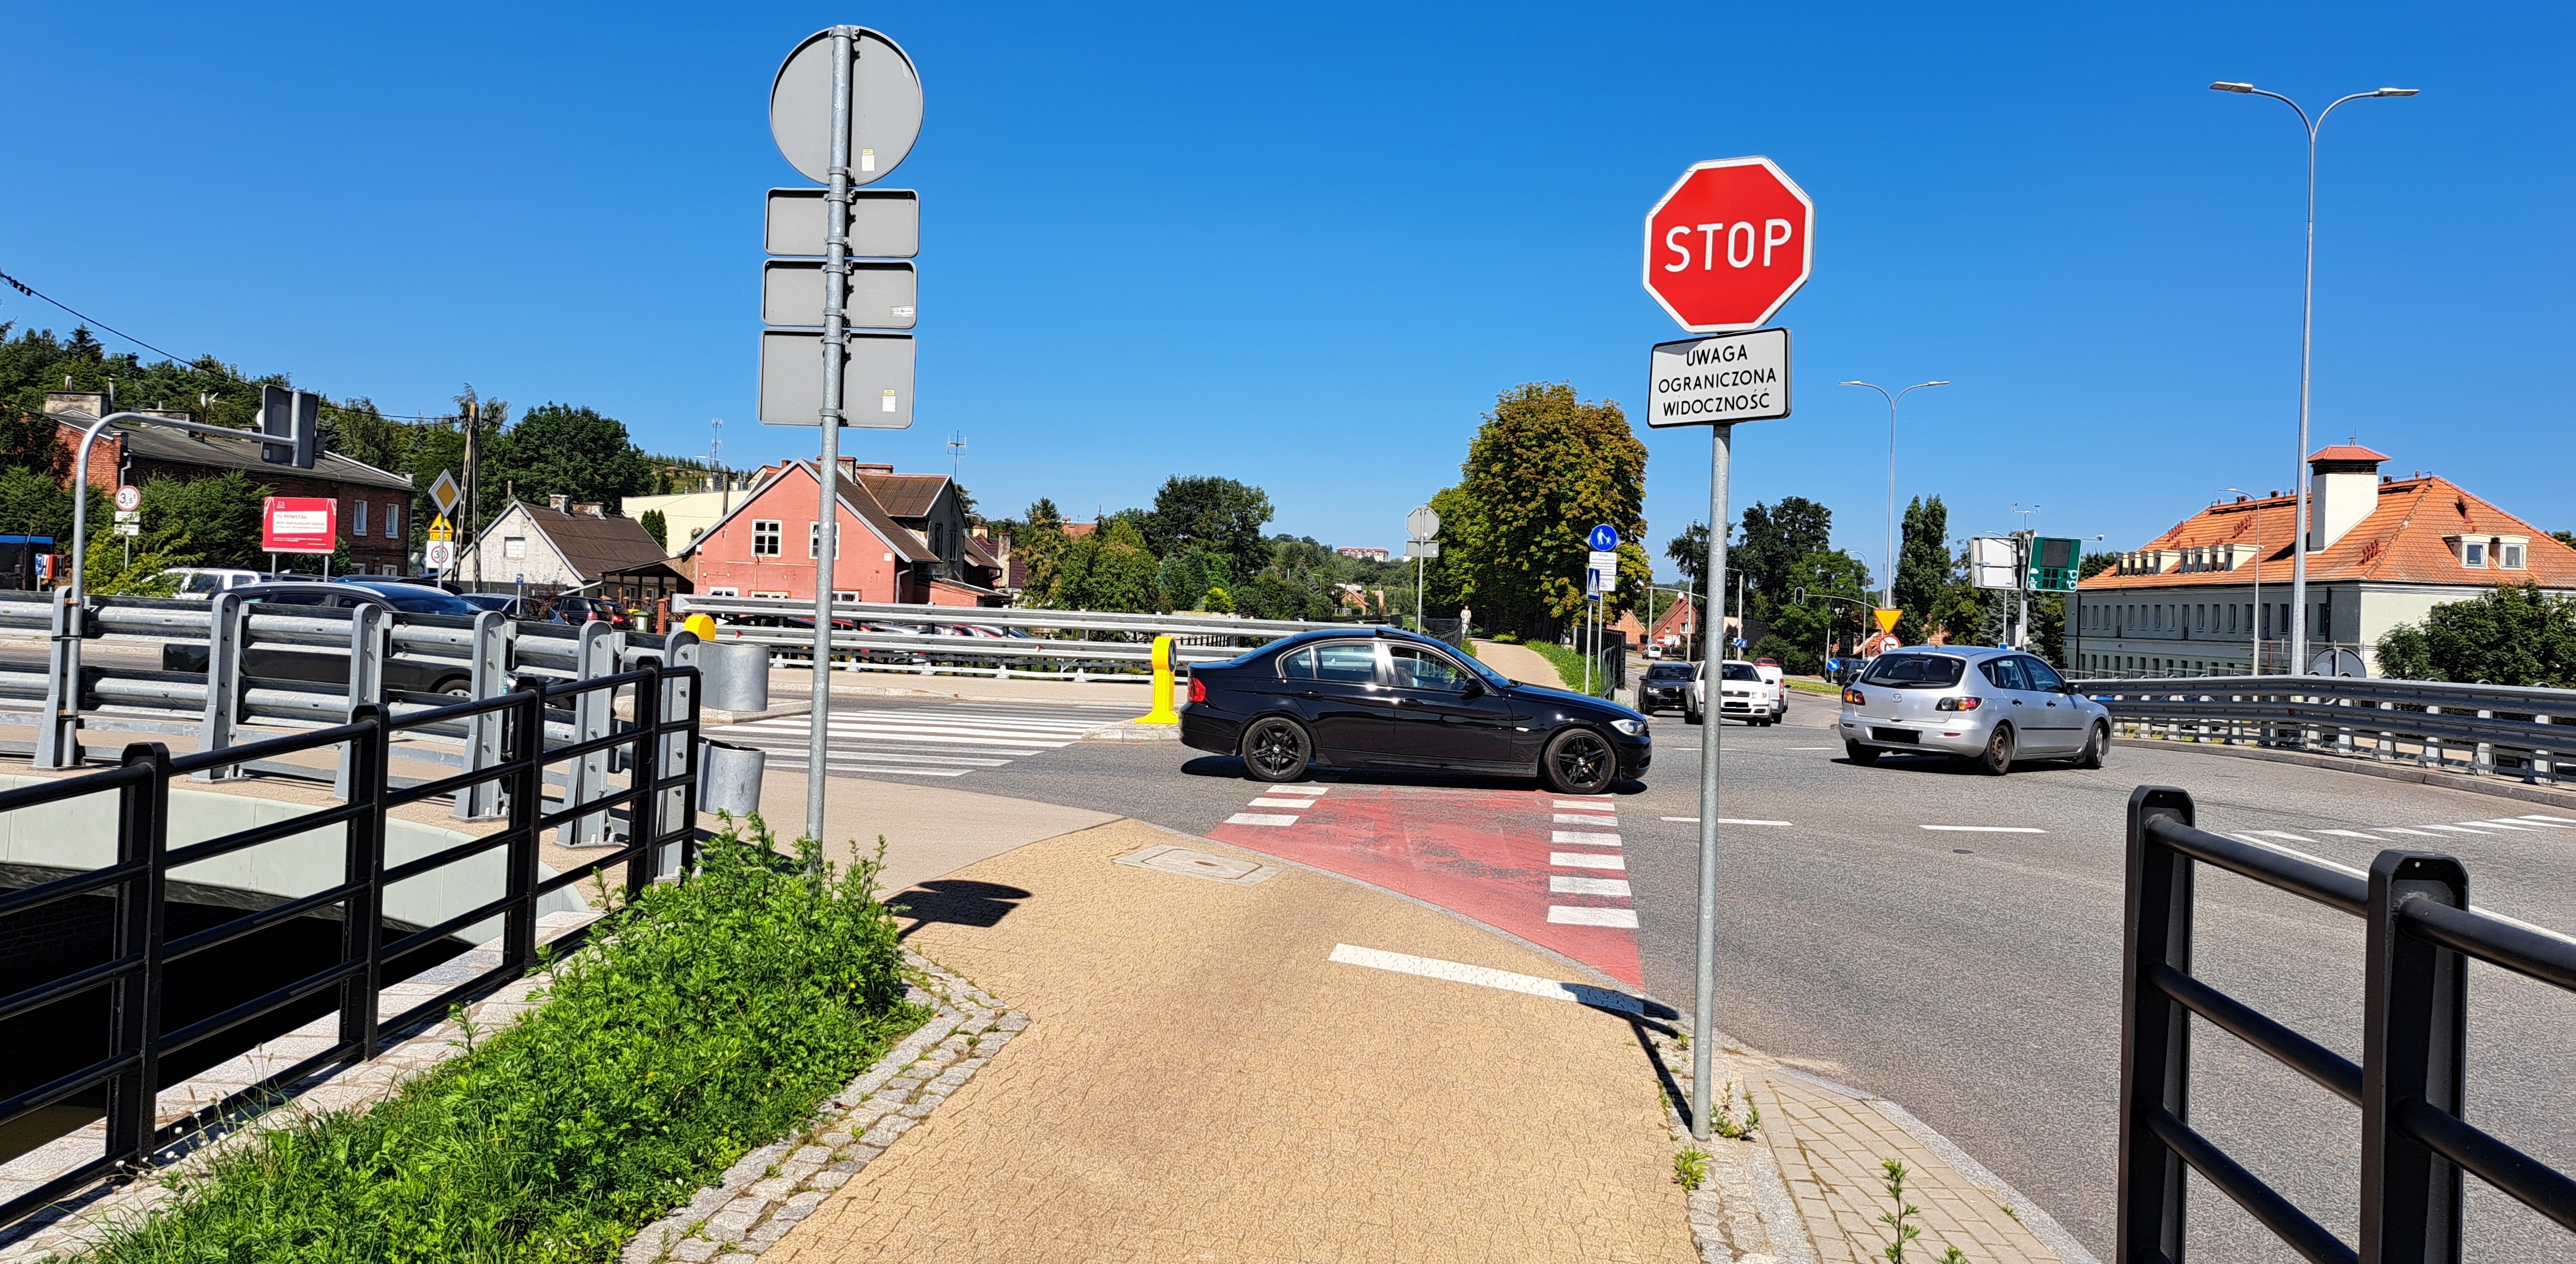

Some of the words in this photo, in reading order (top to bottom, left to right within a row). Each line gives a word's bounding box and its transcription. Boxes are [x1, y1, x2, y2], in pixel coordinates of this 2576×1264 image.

[1664, 218, 1792, 272] STOP
[1686, 344, 1748, 367] UWAGA
[1658, 368, 1777, 394] OGRANICZONA
[1663, 388, 1770, 416] WIDOCZNOŚĆ
